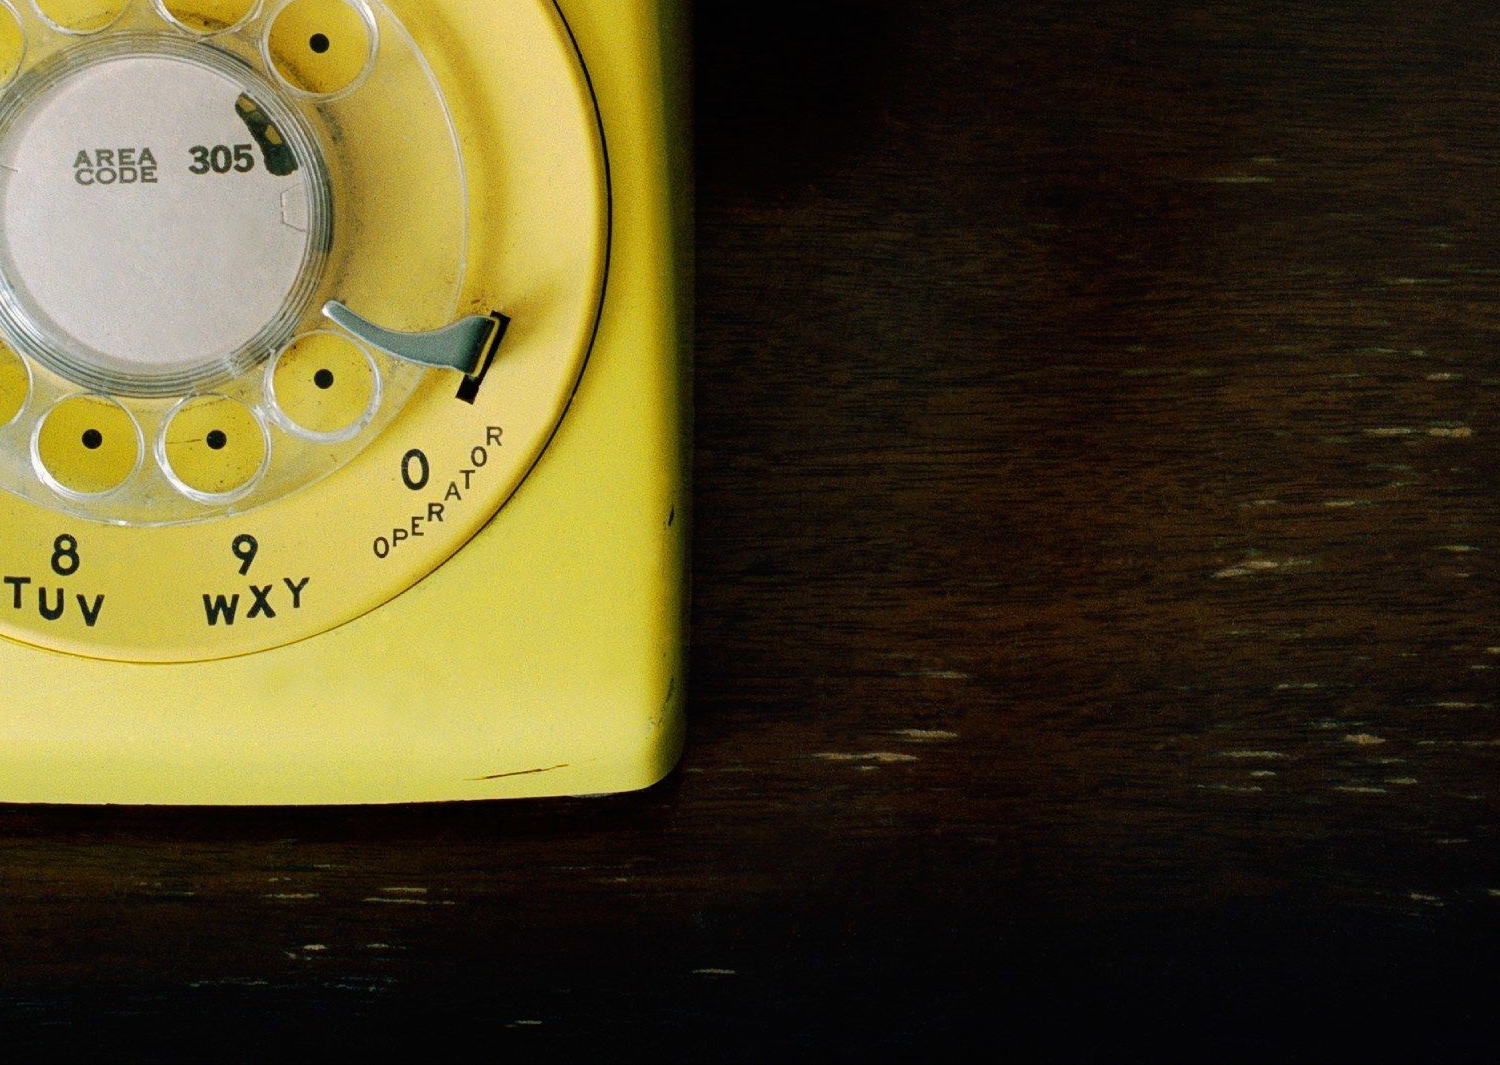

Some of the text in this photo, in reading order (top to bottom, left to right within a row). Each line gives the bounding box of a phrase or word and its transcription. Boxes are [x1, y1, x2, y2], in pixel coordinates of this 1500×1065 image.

[73, 147, 157, 167] AREA
[75, 167, 157, 185] CODE
[188, 144, 255, 175] 305
[401, 449, 429, 490] 0
[373, 426, 503, 559] OPERATOR
[51, 534, 79, 576] 8
[232, 534, 258, 576] 9
[4, 577, 104, 626] TUV
[203, 577, 309, 625] WXY
